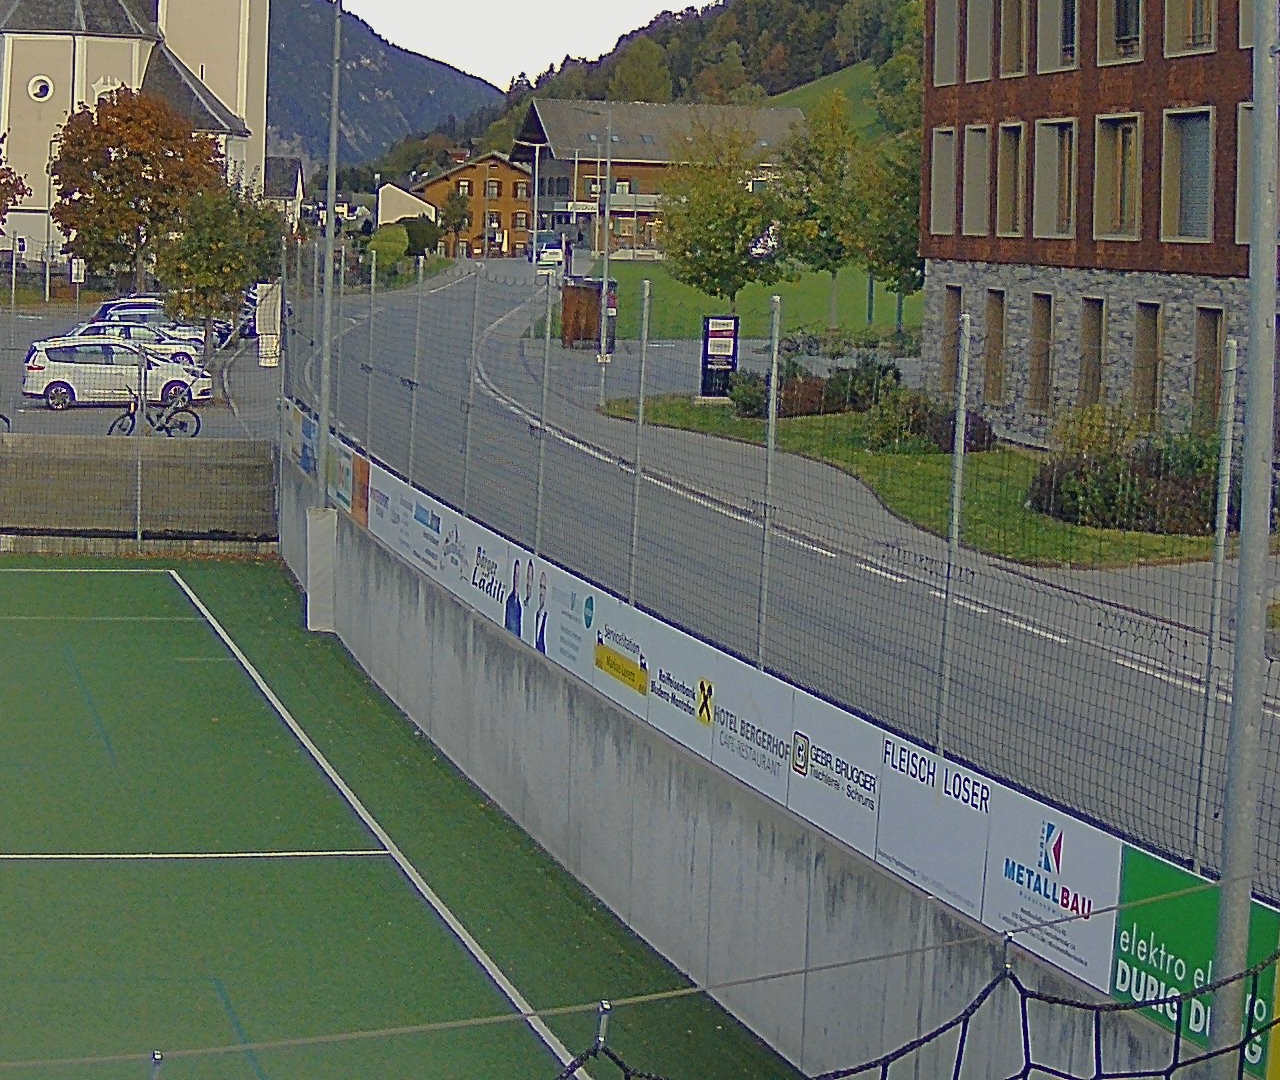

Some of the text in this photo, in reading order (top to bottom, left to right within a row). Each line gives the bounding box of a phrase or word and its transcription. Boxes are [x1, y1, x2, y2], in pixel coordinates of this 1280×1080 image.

[714, 705, 791, 760] HOTEL BERGERHOF
[846, 784, 875, 811] Schruns
[883, 739, 990, 814] FLEISCH LOSER
[1004, 857, 1092, 920] METALLBAU
[1120, 922, 1186, 981] elektro
